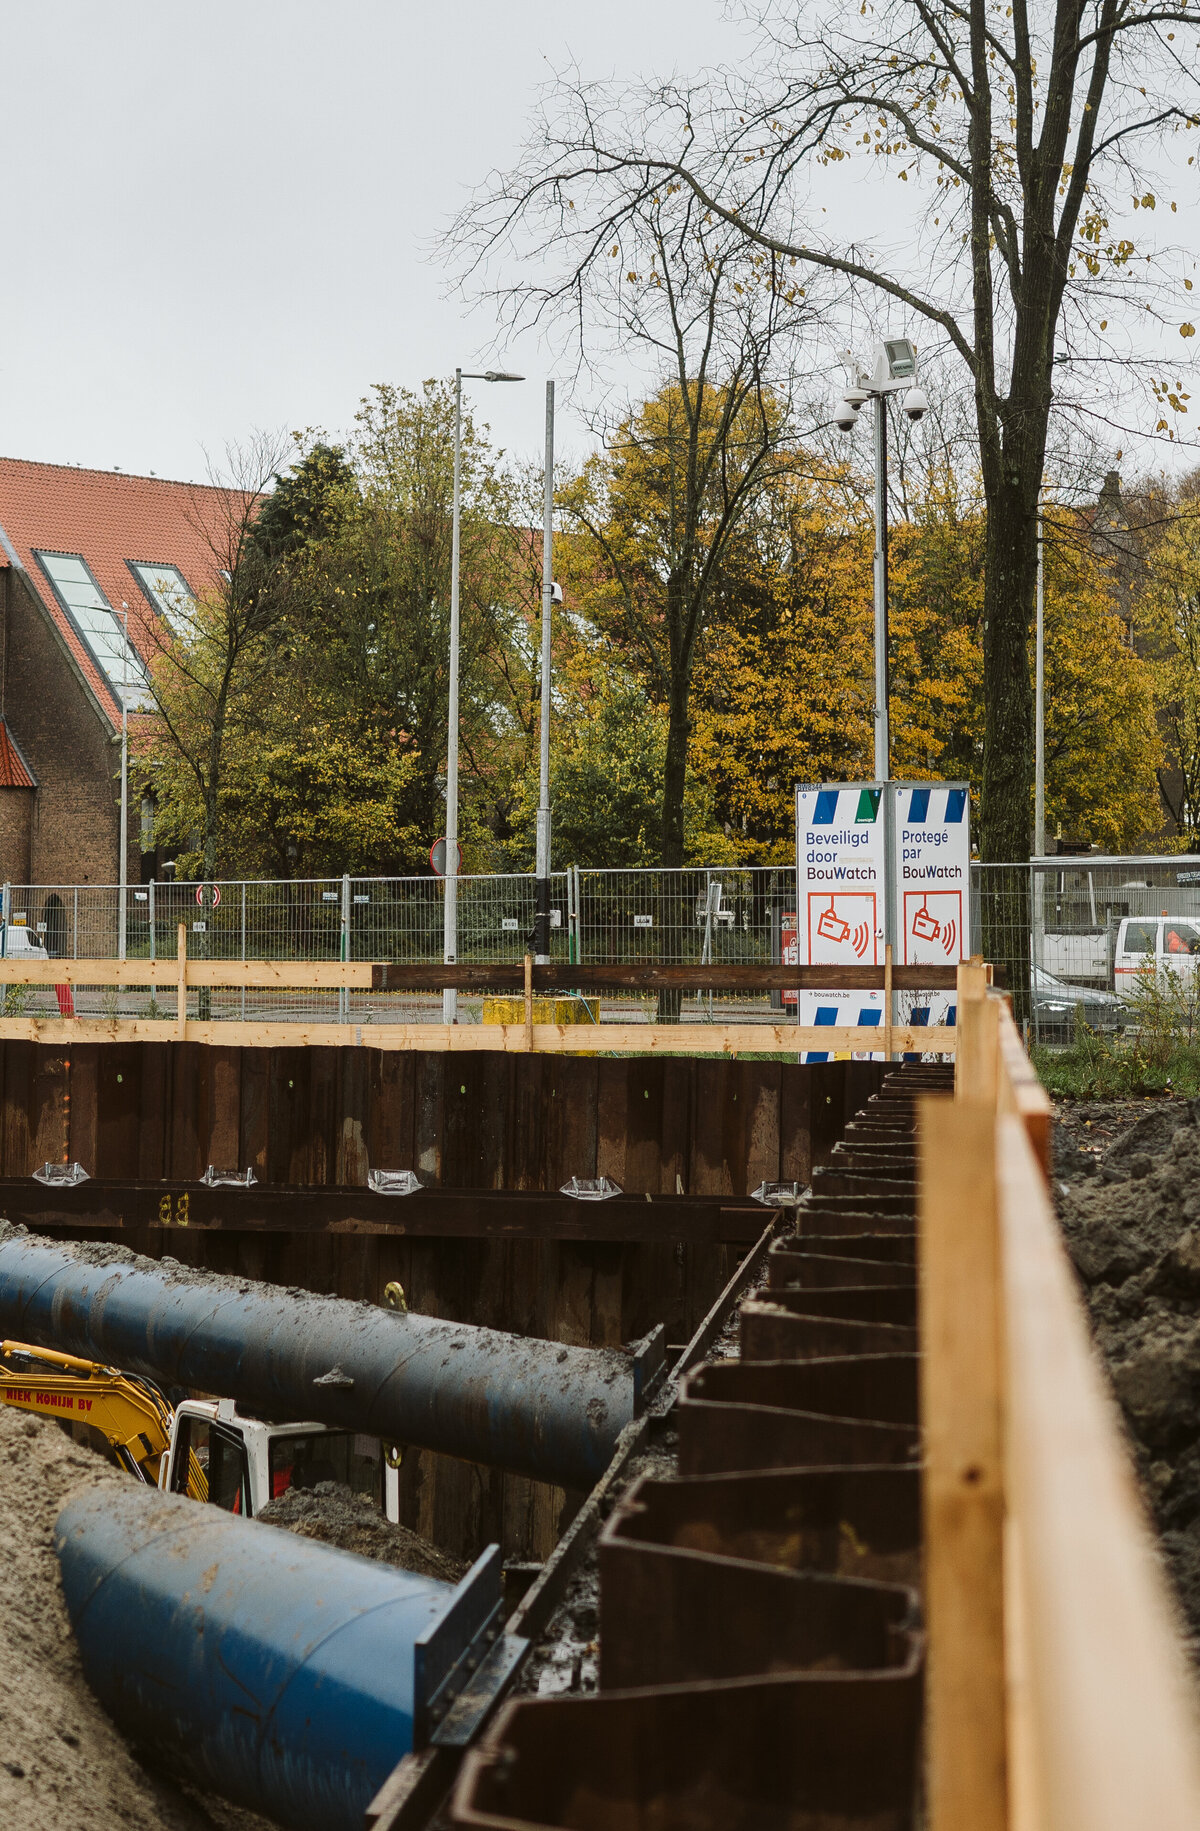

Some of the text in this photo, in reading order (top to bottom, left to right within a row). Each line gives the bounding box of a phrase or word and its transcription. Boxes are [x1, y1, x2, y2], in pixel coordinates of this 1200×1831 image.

[807, 830, 869, 847] Beveiligd
[902, 828, 949, 847] Protegé
[806, 849, 838, 863] door
[902, 848, 922, 863] par
[807, 866, 877, 880] BouWatch
[902, 864, 962, 879] BouWatch
[36, 1393, 73, 1408] KONIJN
[78, 1398, 93, 1411] BV
